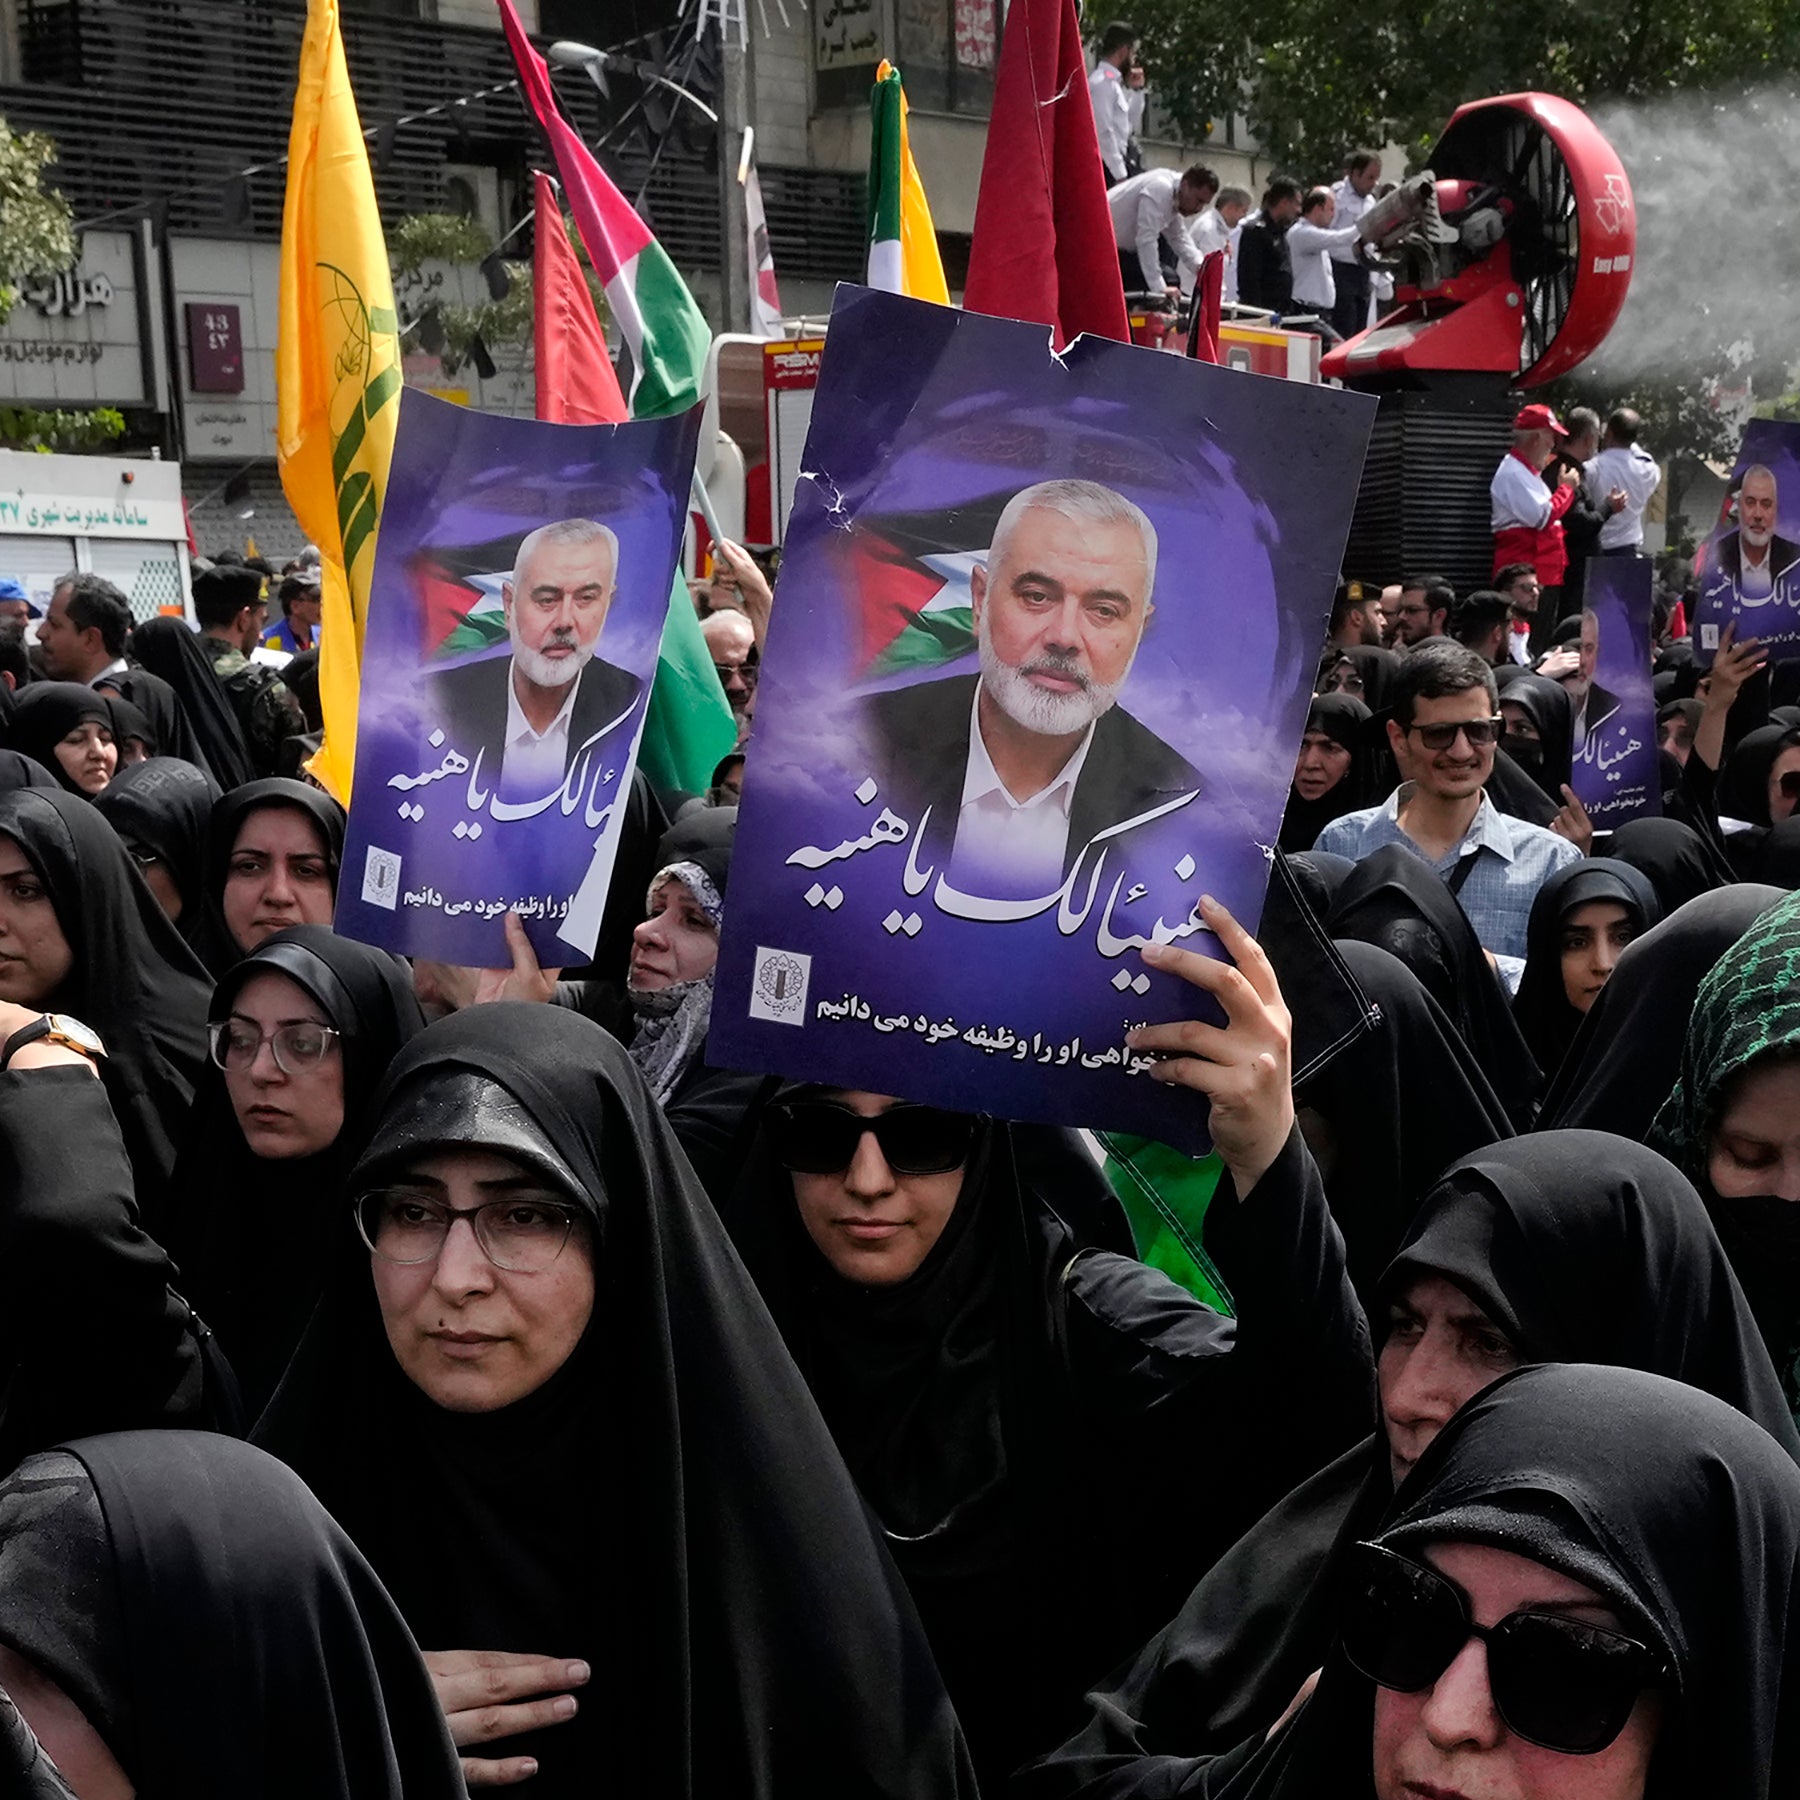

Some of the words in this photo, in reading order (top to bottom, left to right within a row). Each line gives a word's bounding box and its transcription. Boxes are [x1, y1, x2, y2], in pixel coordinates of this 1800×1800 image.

[113, 503, 149, 526] سامانه
[387, 727, 470, 823] هنیه
[786, 777, 910, 910] هنیه
[403, 885, 443, 908] دانیم
[444, 899, 472, 916] می
[474, 896, 507, 921] خود
[816, 992, 871, 1021] دانیم
[873, 1011, 910, 1032] می
[912, 1013, 959, 1044] خود
[962, 1027, 1028, 1060] وظیفه
[1033, 1031, 1053, 1064] را
[1055, 1037, 1080, 1066] او
